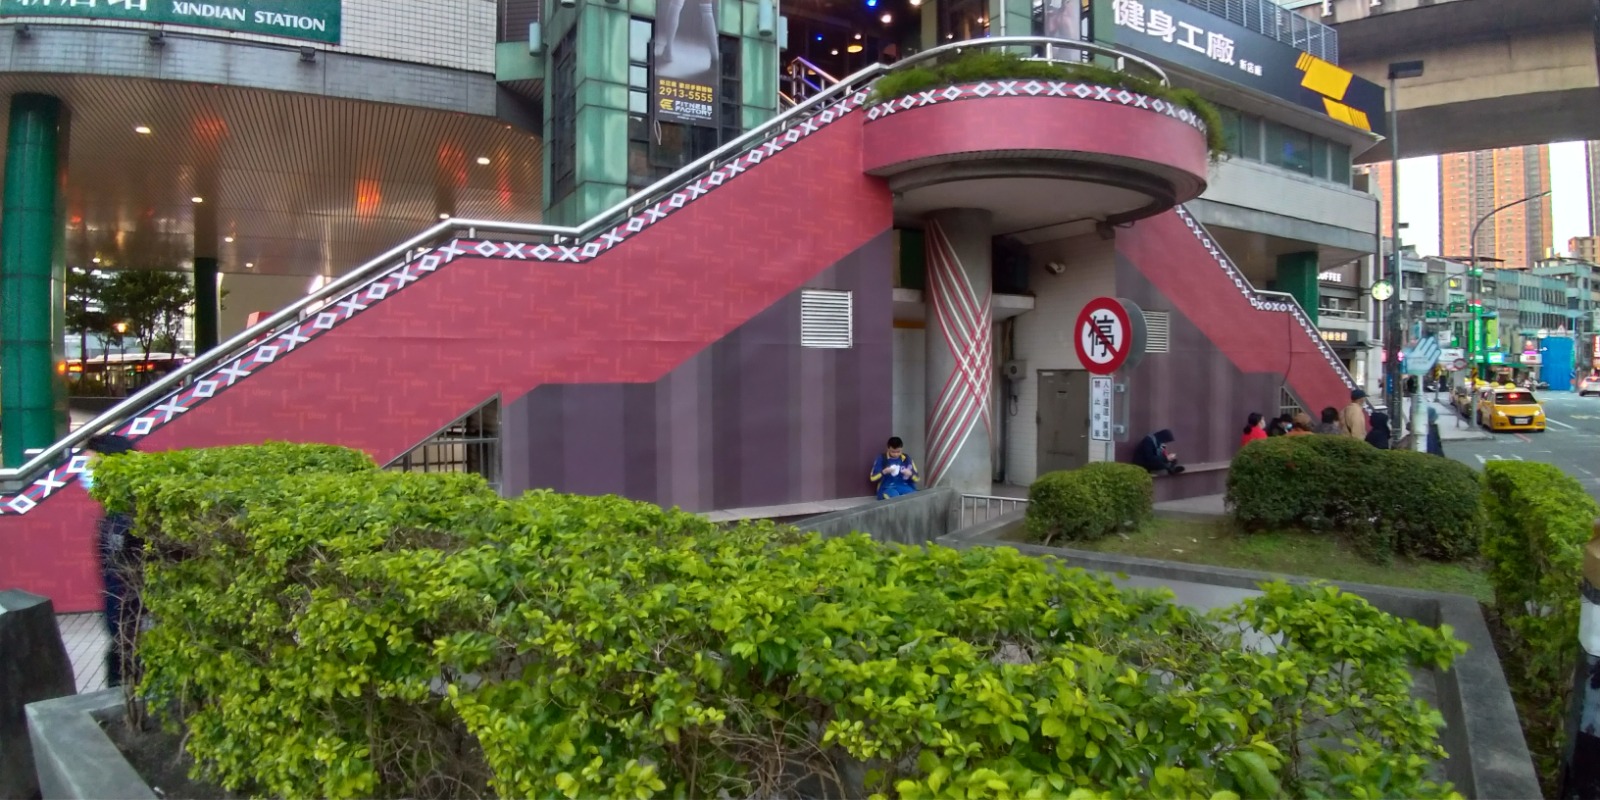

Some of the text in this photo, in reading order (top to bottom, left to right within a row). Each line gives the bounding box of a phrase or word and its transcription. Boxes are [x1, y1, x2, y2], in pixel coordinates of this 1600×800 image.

[172, 1, 246, 21] XINDIAN
[254, 10, 326, 32] STATION
[1112, 0, 1235, 66] 健身工廠
[659, 86, 713, 103] 2913-5555
[675, 100, 713, 112] FITNESS
[675, 105, 713, 117] FACTORY
[1088, 314, 1115, 358] 停
[1094, 380, 1102, 437] 禁止停車
